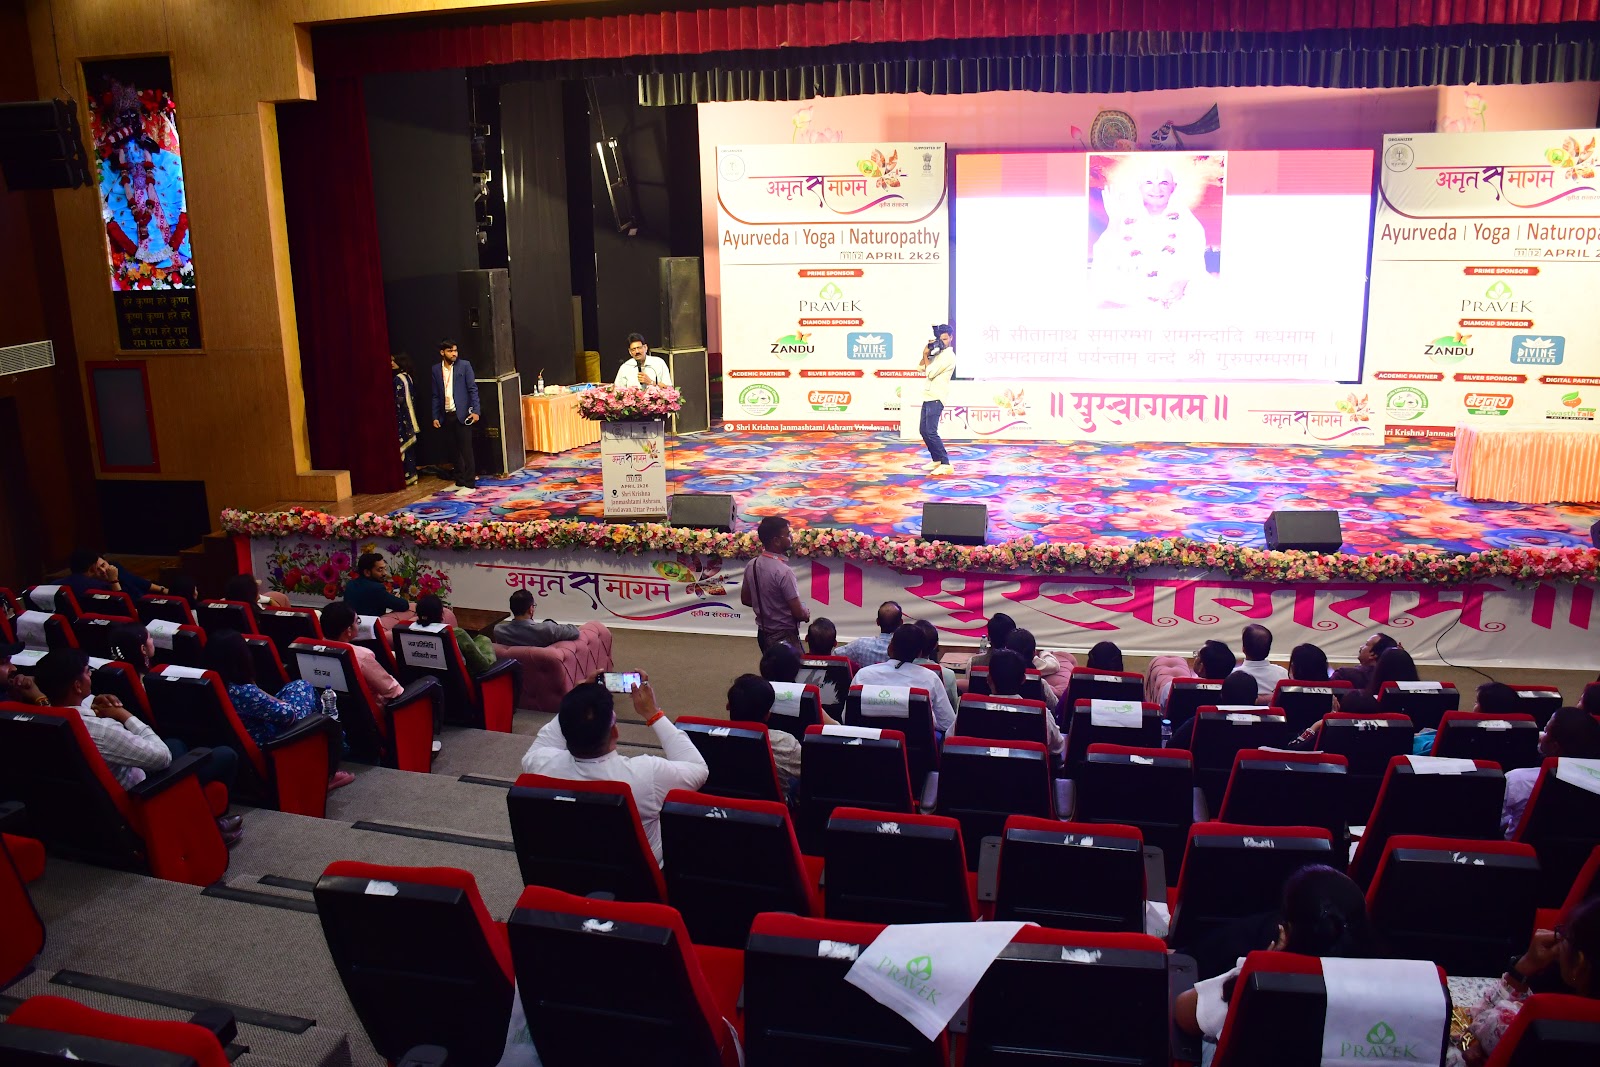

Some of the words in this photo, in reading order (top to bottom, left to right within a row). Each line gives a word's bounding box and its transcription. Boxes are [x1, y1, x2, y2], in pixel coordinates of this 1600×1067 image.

[723, 228, 789, 249] Ayurveda
[803, 228, 835, 249] Yoga
[850, 227, 940, 249] Naturopathy
[1381, 222, 1457, 244] Ayurveda
[1474, 223, 1510, 244] Yoga
[866, 252, 904, 260] APRIL
[909, 252, 940, 260] 2k26
[1544, 249, 1590, 257] APRIL
[771, 343, 815, 354] ZANDU
[853, 344, 886, 353] DIVINE
[1424, 344, 1474, 356] ZANDU
[1517, 348, 1556, 358] DIVINE
[780, 424, 826, 432] Janmashtami
